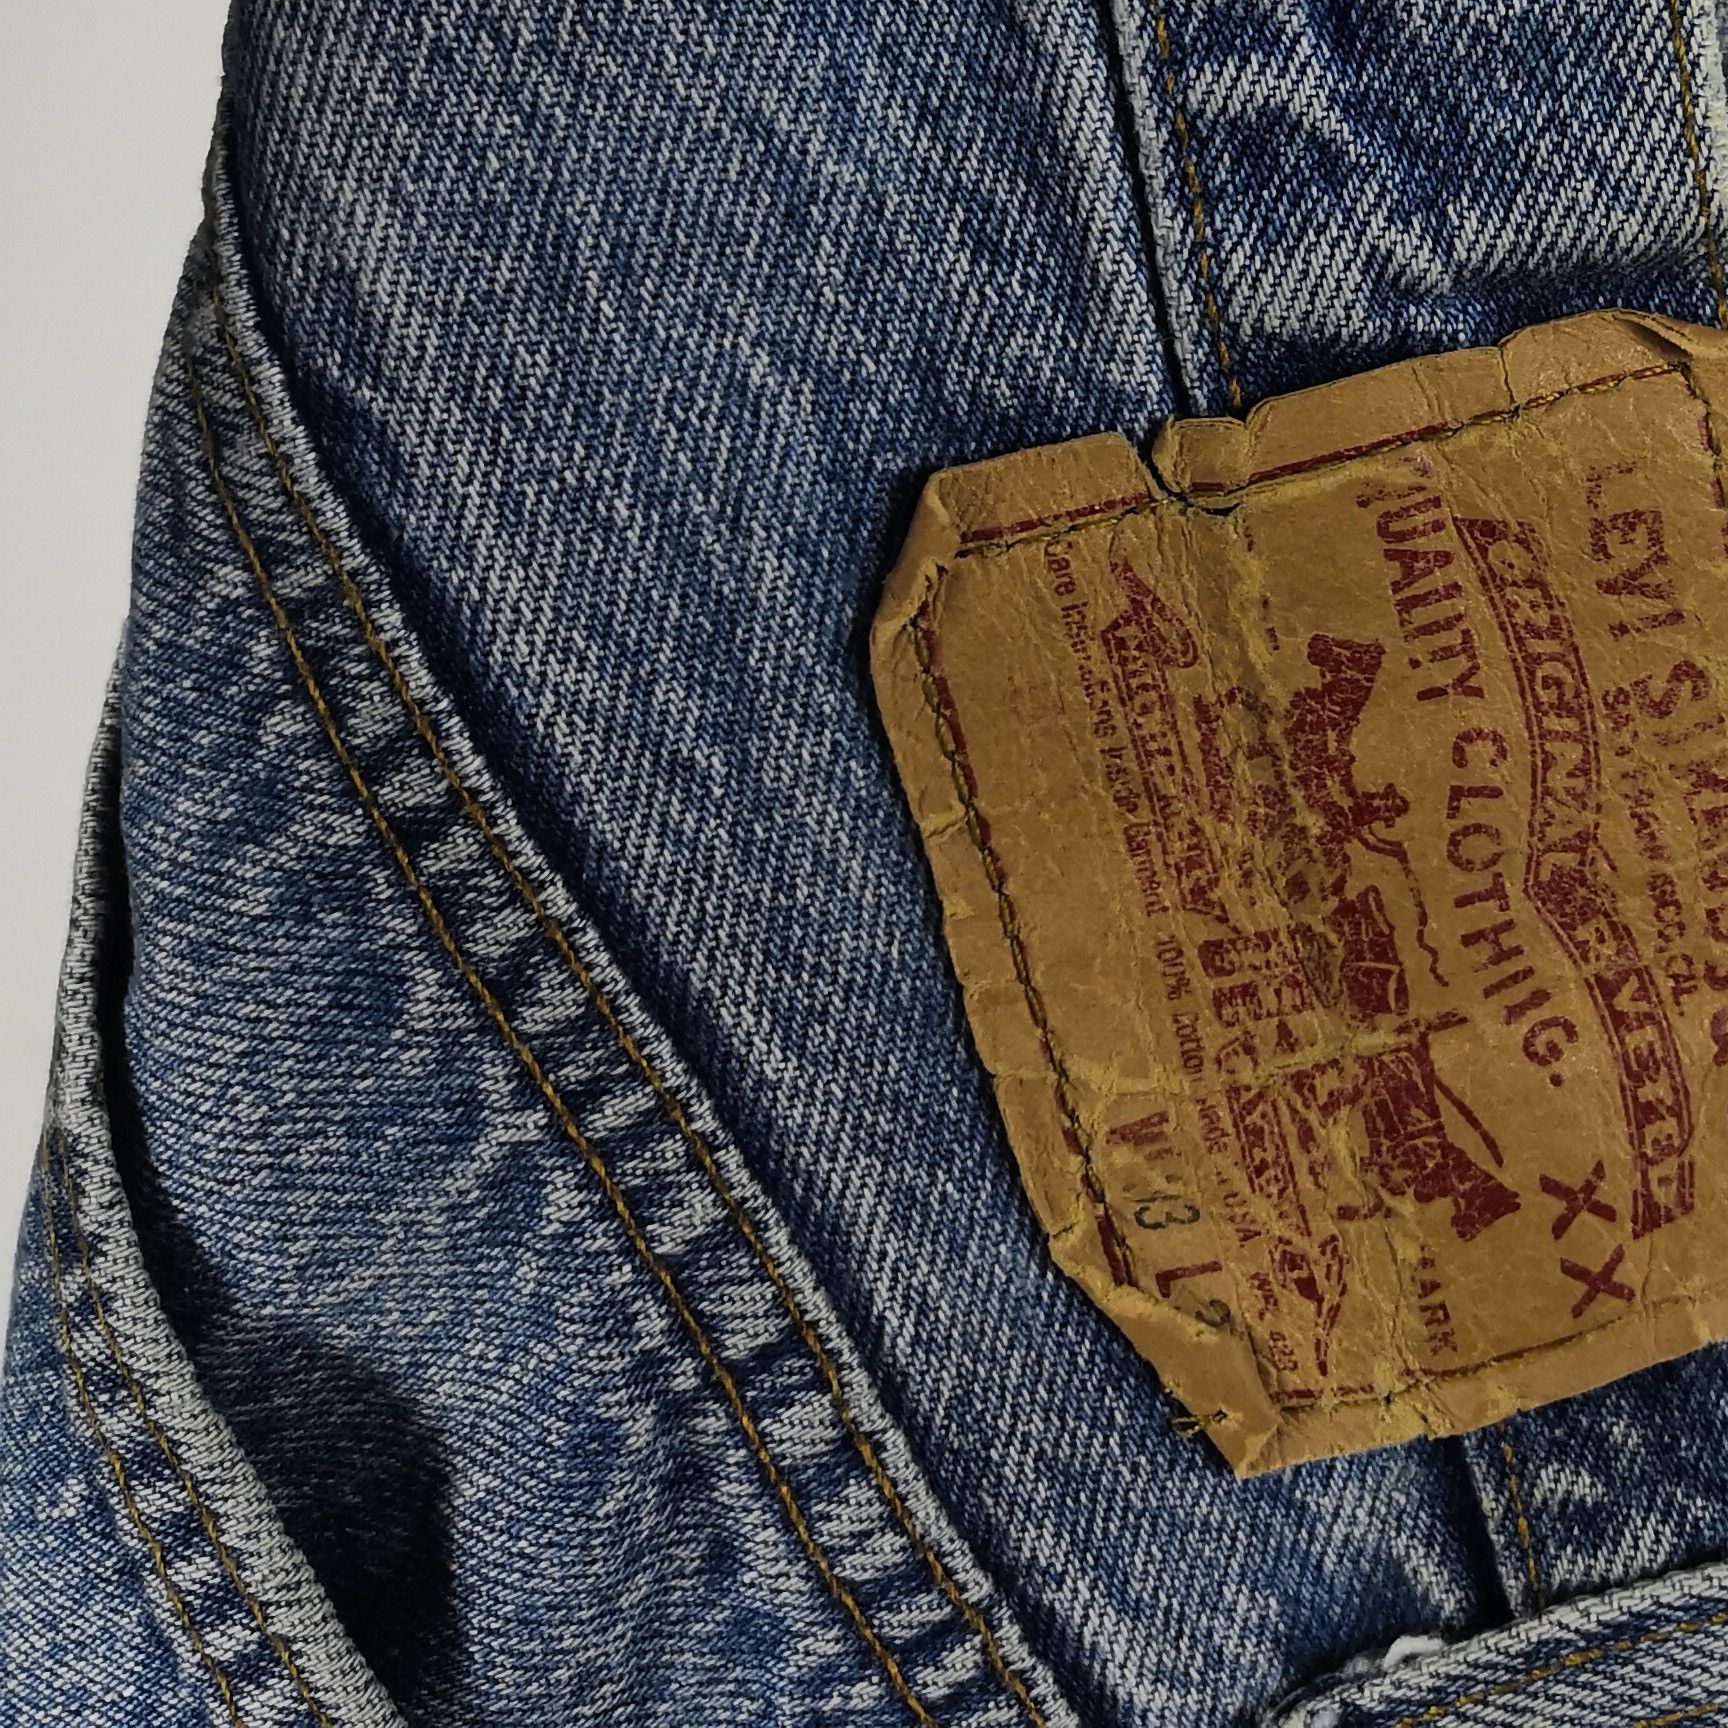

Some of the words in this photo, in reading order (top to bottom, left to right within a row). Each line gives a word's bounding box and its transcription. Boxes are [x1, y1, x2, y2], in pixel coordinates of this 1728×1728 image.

[1584, 455, 1687, 640] LEVI
[1154, 933, 1193, 1002] 100%
[1574, 914, 1683, 1217] RVETED
